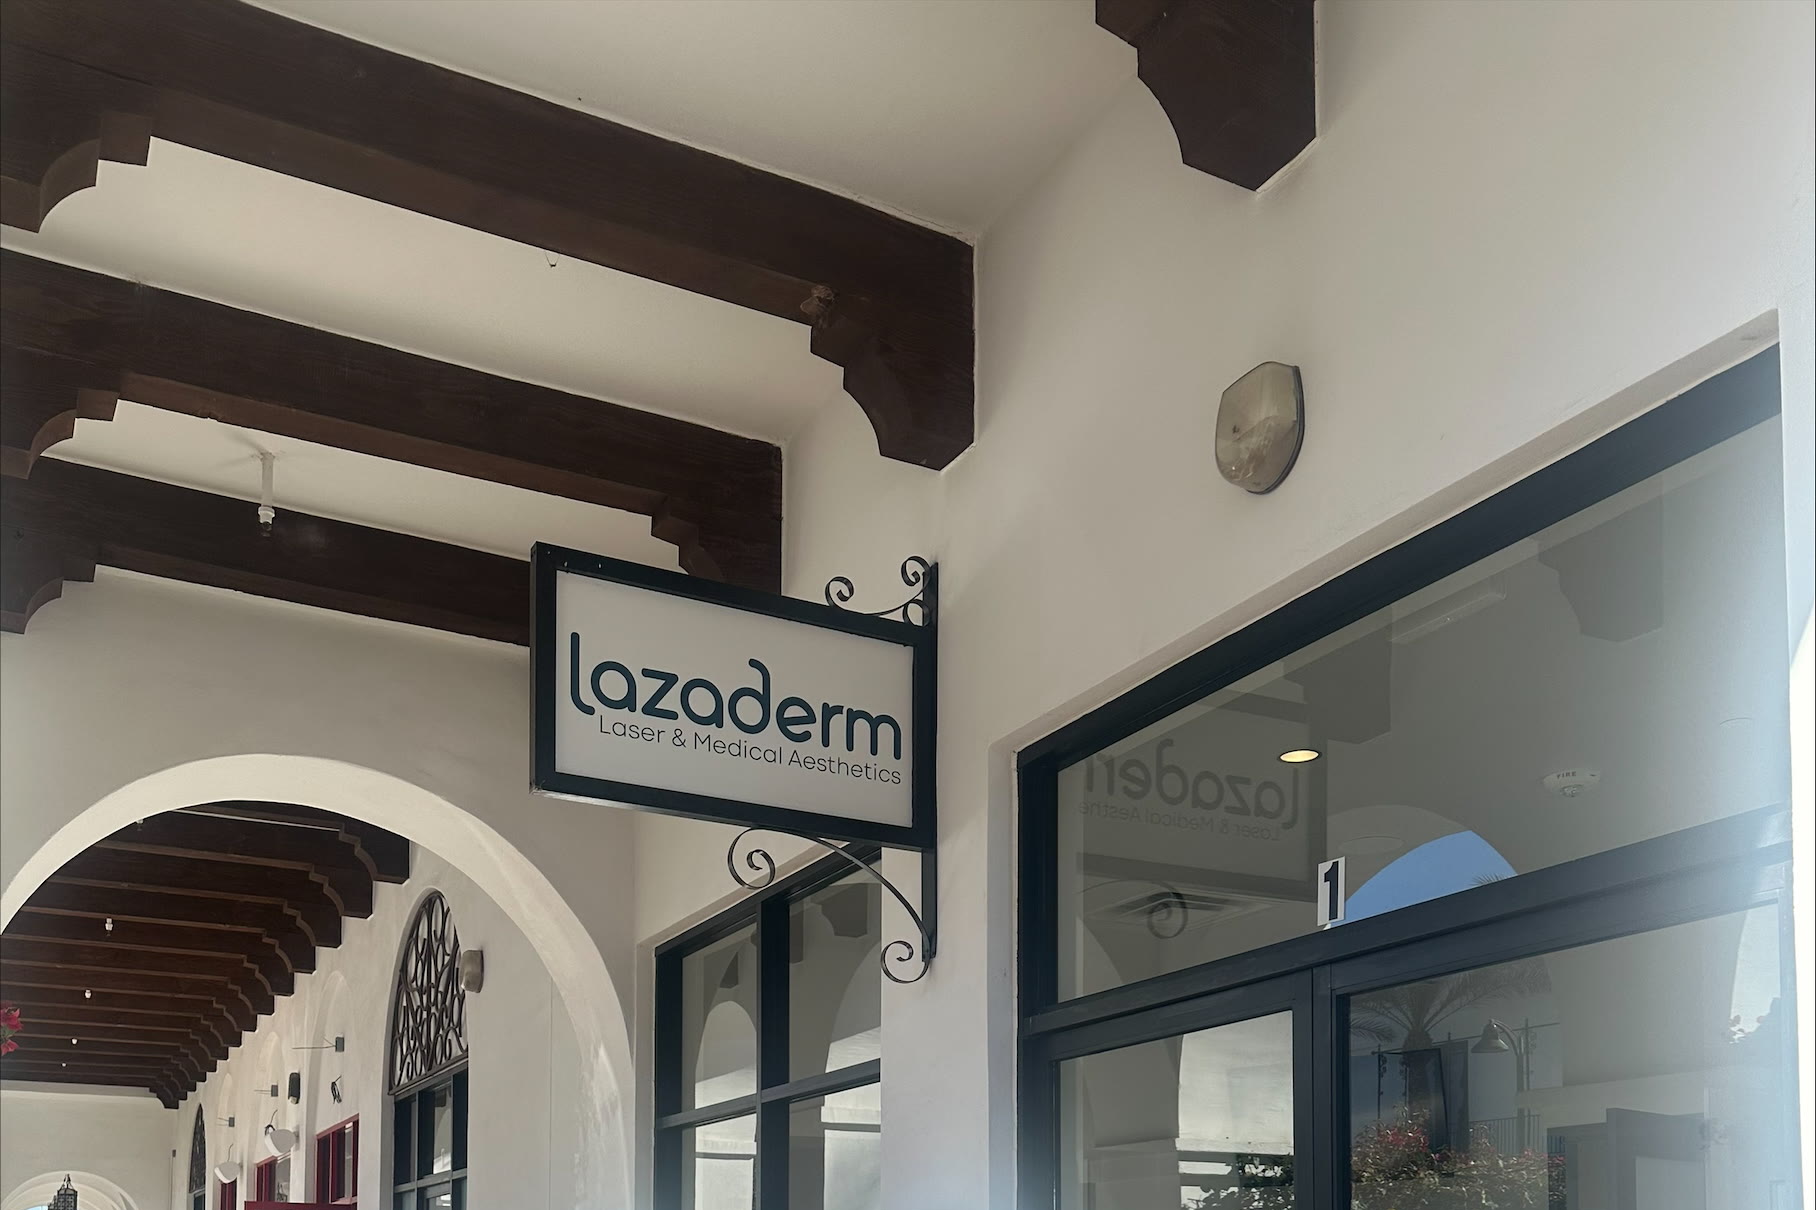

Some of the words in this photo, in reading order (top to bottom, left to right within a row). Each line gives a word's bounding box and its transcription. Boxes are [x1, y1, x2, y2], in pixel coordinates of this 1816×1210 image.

[570, 632, 902, 760] lazaderm
[600, 715, 665, 745] Laser
[671, 728, 687, 748] &
[694, 731, 783, 765] Medical
[788, 750, 902, 785] Aesthetics
[1323, 860, 1339, 921] 1
